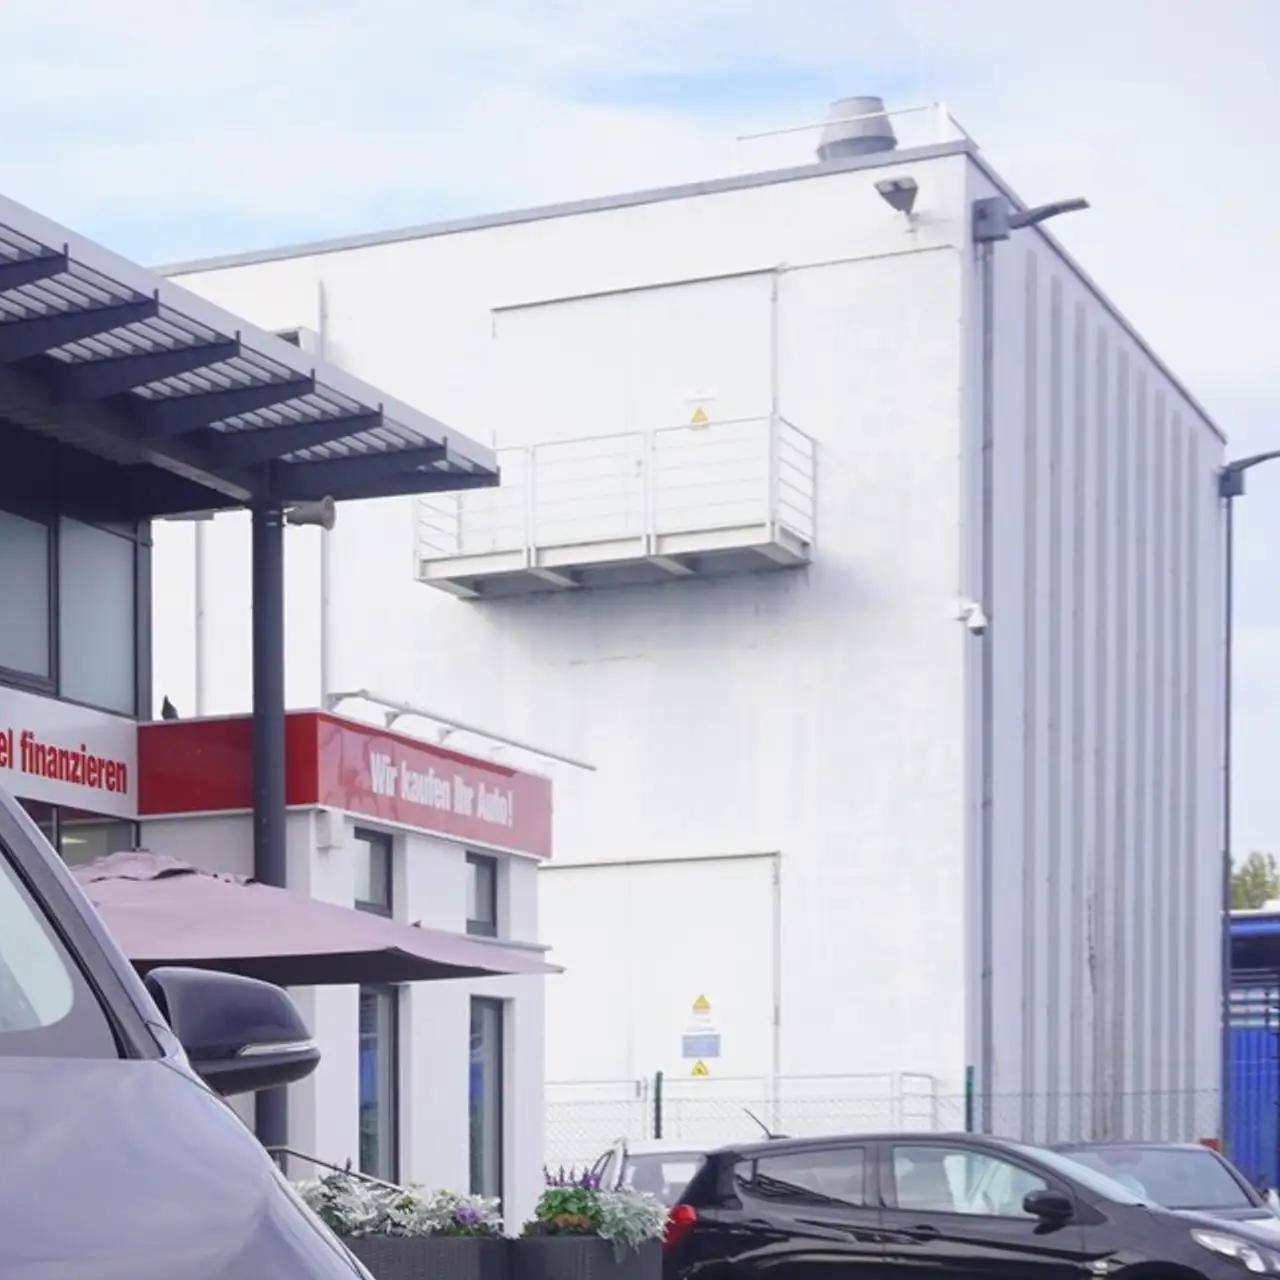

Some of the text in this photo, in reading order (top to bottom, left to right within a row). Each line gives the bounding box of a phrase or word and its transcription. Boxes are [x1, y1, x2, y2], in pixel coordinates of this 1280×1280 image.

[20, 729, 128, 794] finanzieren
[370, 752, 514, 828] Wir kaufen Ihr Auto!
